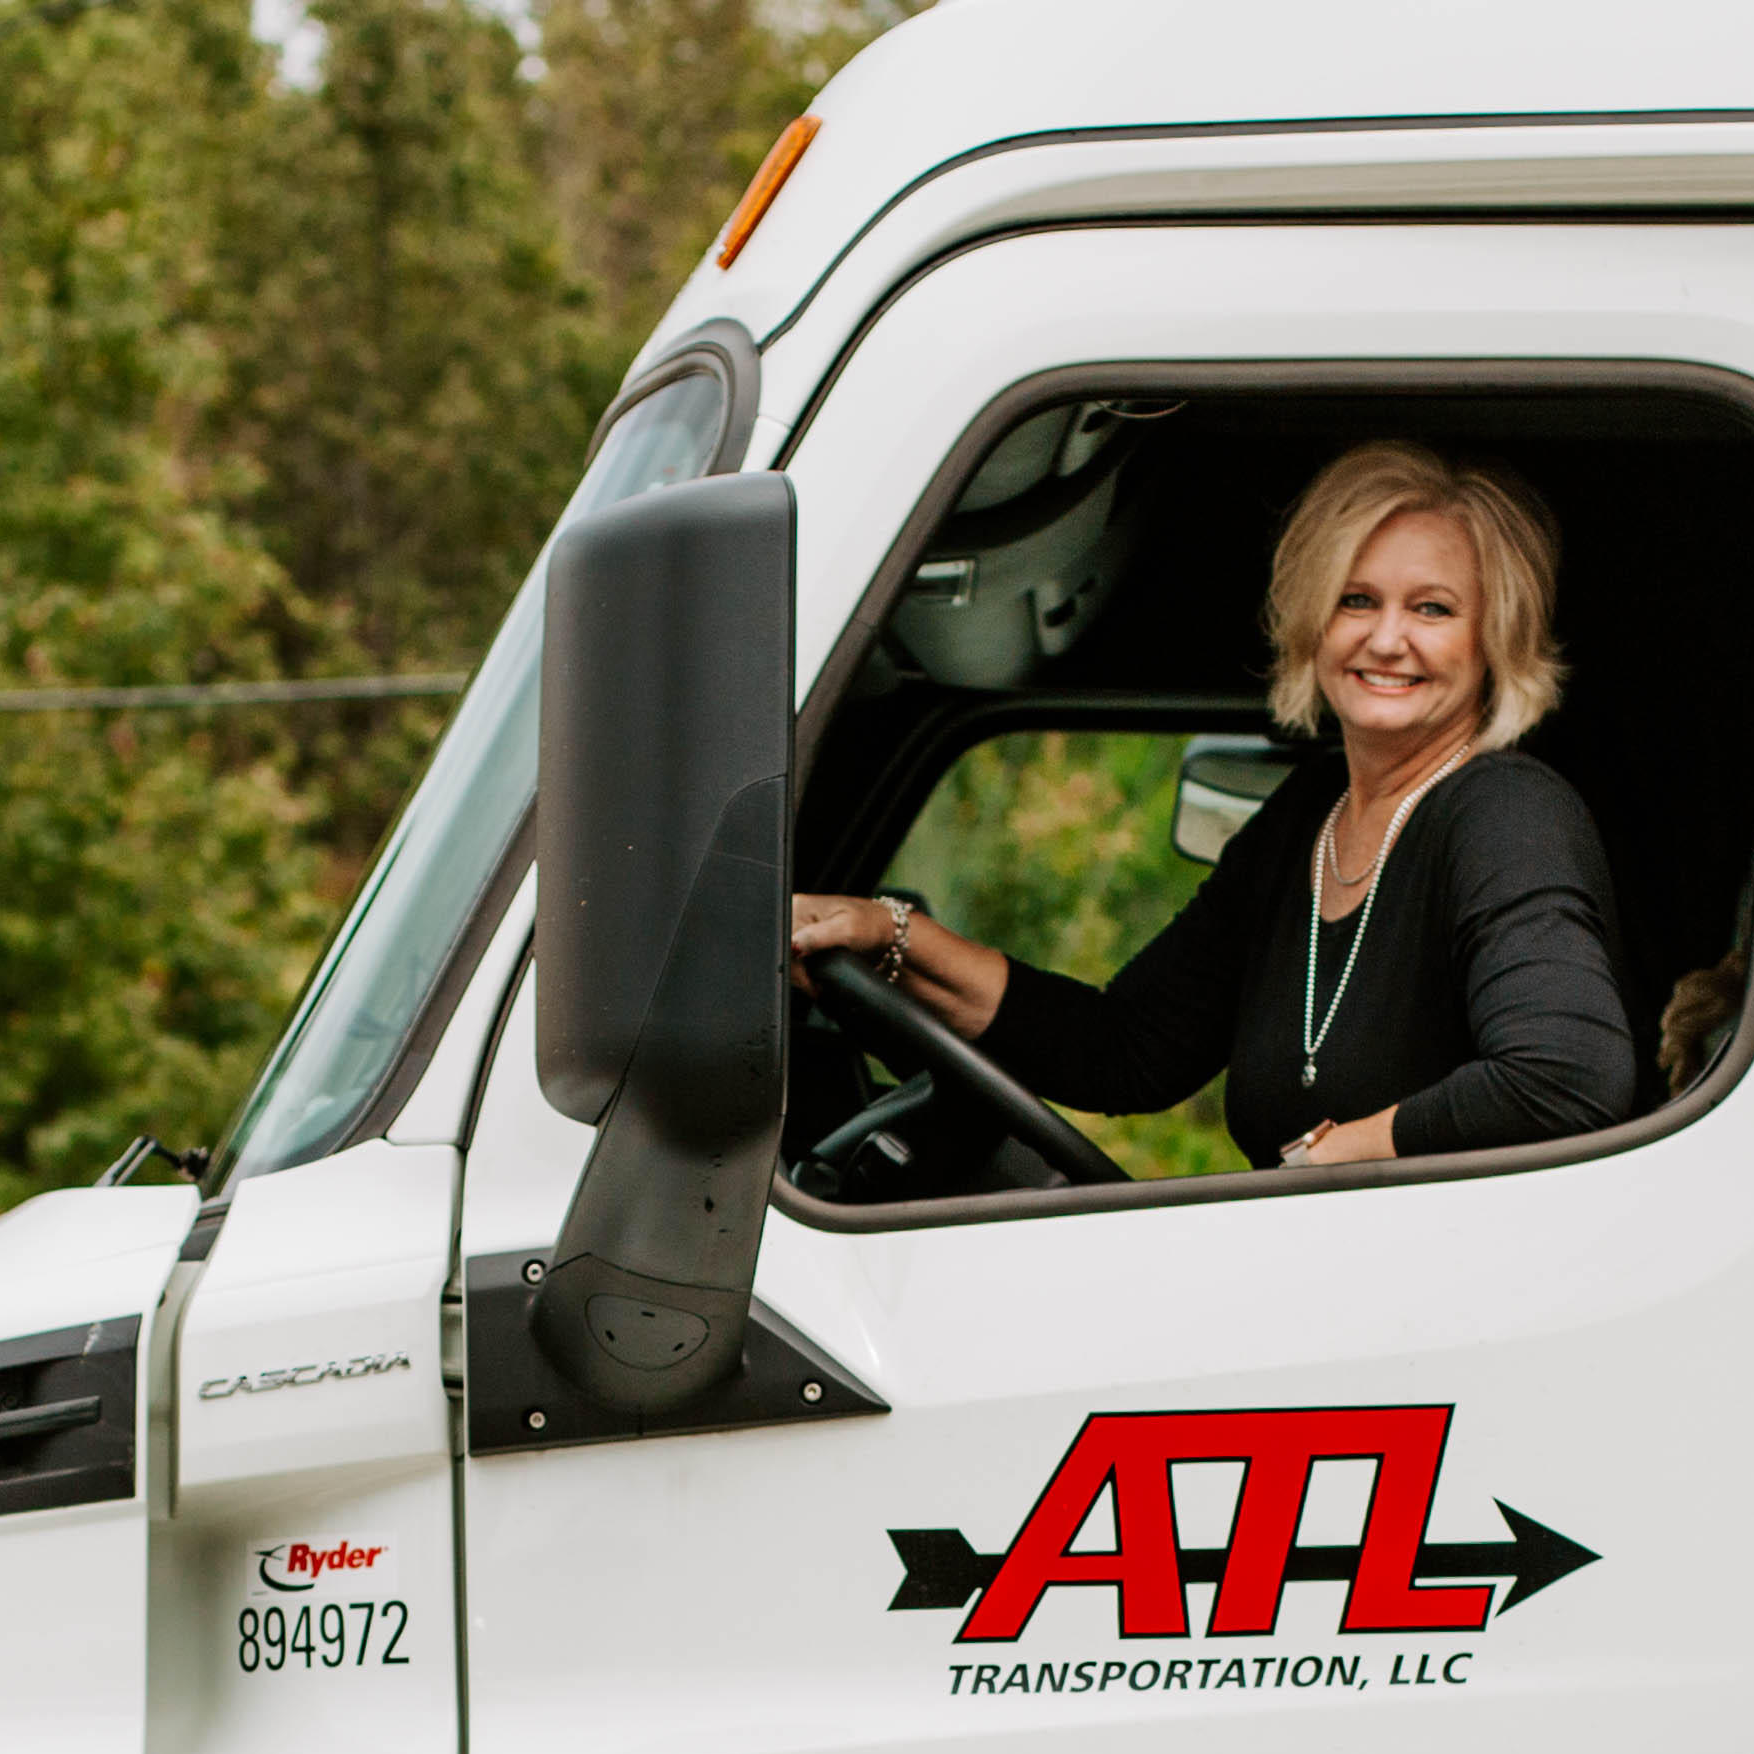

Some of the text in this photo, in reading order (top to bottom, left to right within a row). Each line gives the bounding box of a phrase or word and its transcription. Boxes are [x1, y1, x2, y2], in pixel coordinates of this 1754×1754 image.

[198, 1351, 411, 1400] CASCADIA
[953, 1403, 1497, 1643] ATL
[287, 1541, 383, 1578] Ryder
[238, 1599, 410, 1673] 894972
[948, 1652, 1473, 1695] TRANSPORTATION, LLC
